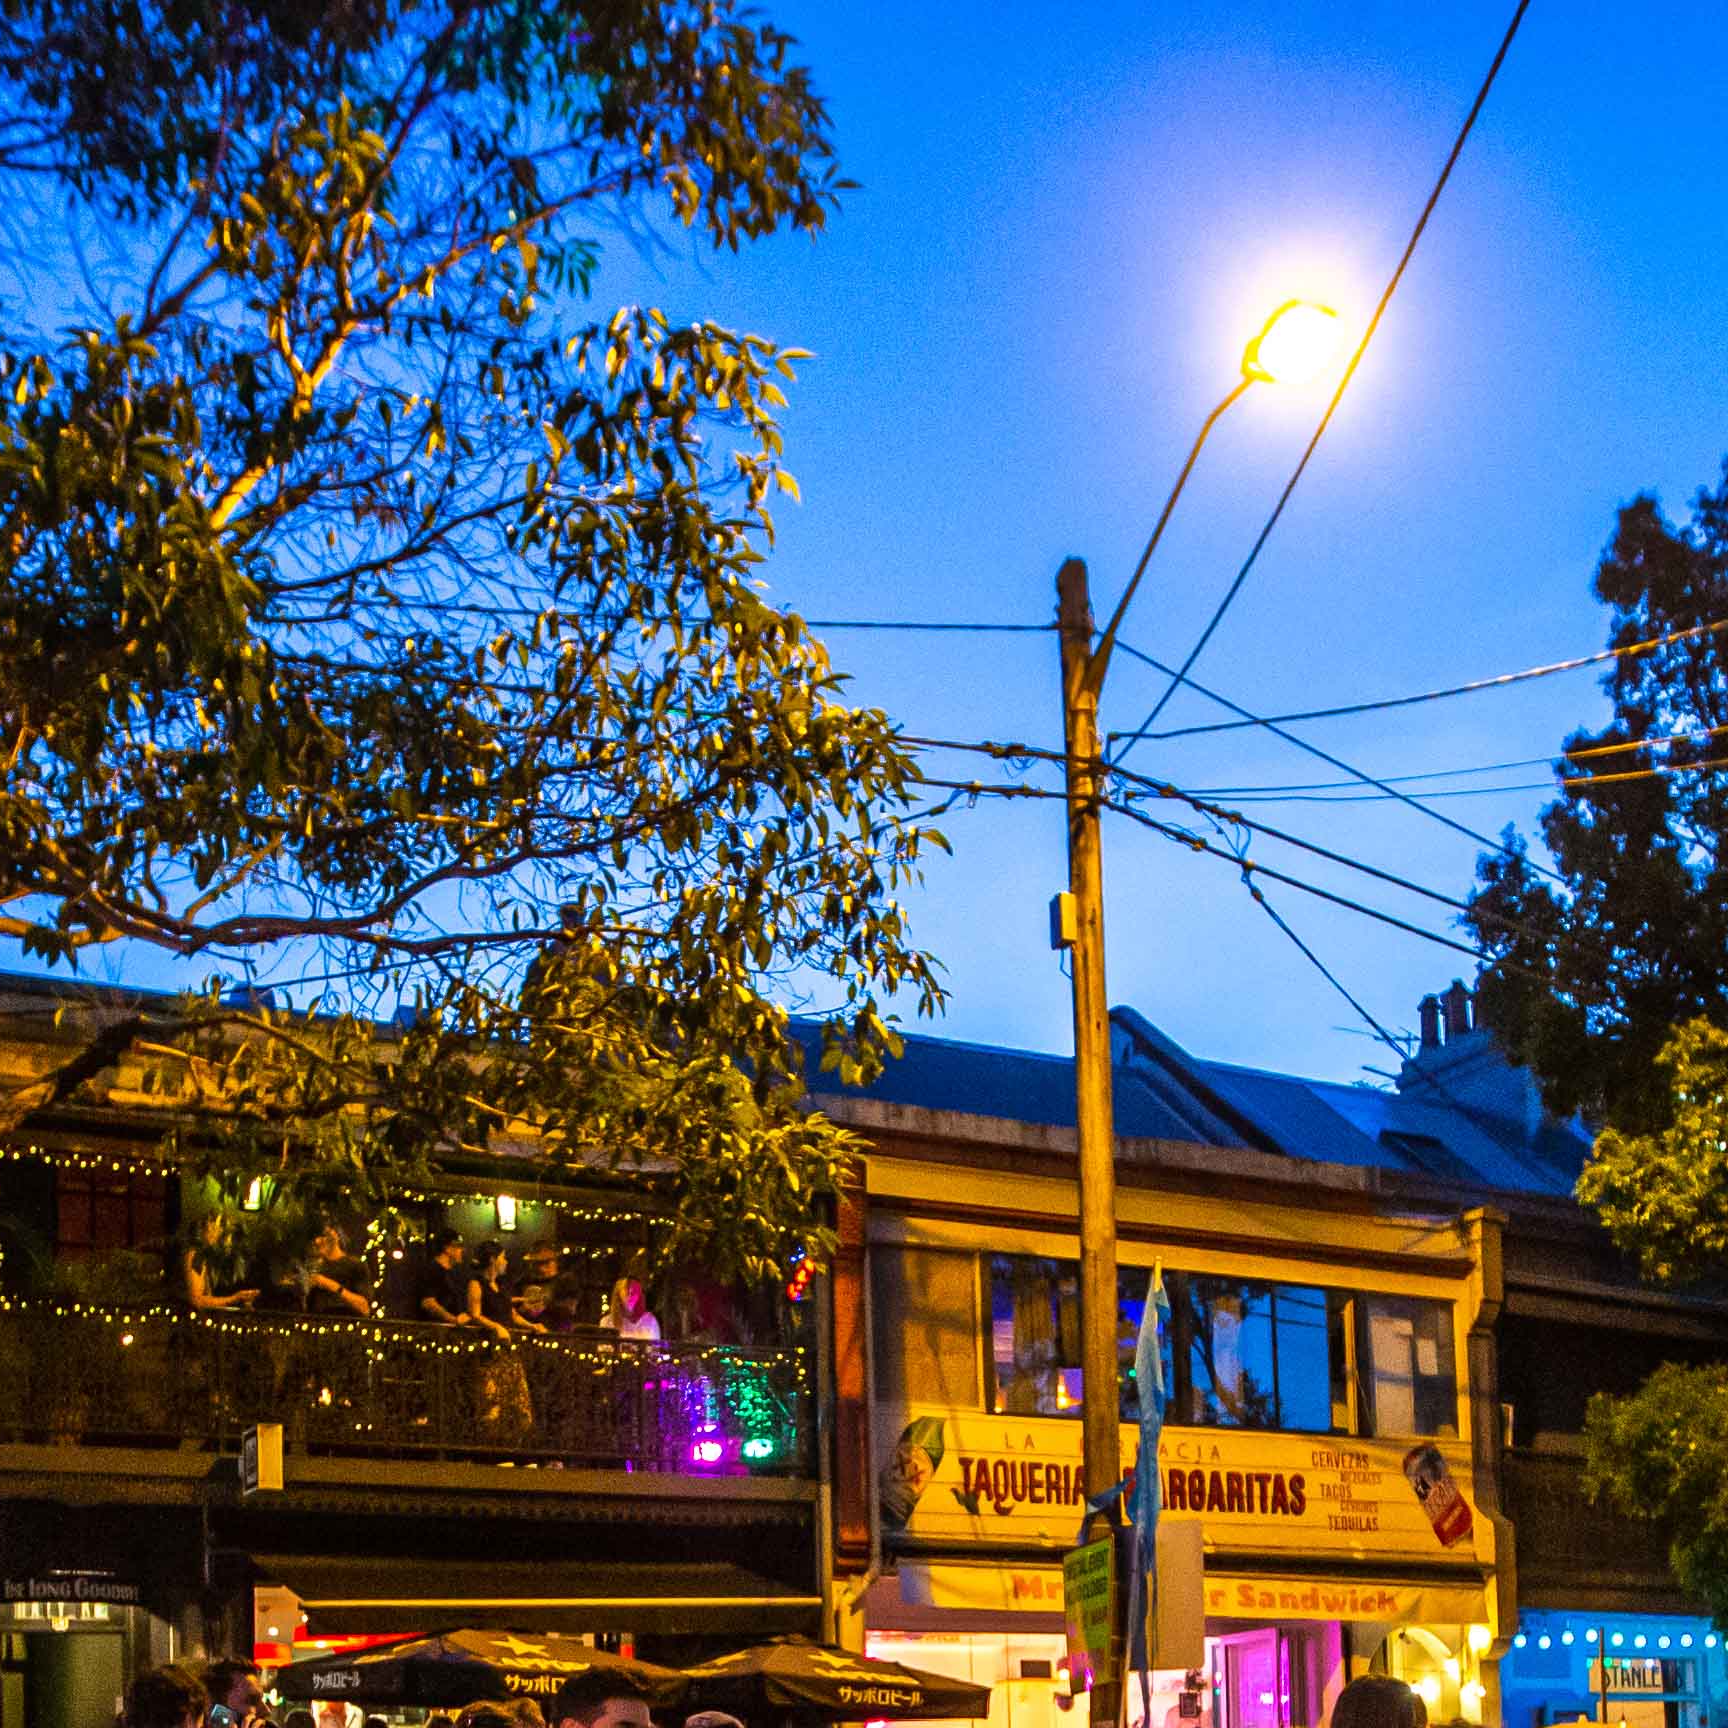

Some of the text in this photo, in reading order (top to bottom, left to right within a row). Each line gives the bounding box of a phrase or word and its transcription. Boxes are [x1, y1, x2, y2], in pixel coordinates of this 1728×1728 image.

[1005, 1432, 1036, 1450] LA
[1311, 1450, 1370, 1470] CERVEZAS
[958, 1456, 1085, 1516] TAQUERIA
[1319, 1482, 1353, 1498] TACOS
[1327, 1514, 1380, 1532] TEQUILAS
[28, 1578, 72, 1599] LONG
[1013, 1574, 1064, 1600] Mr
[1236, 1583, 1399, 1615] Sandwich
[838, 1685, 924, 1708] サッポロビール
